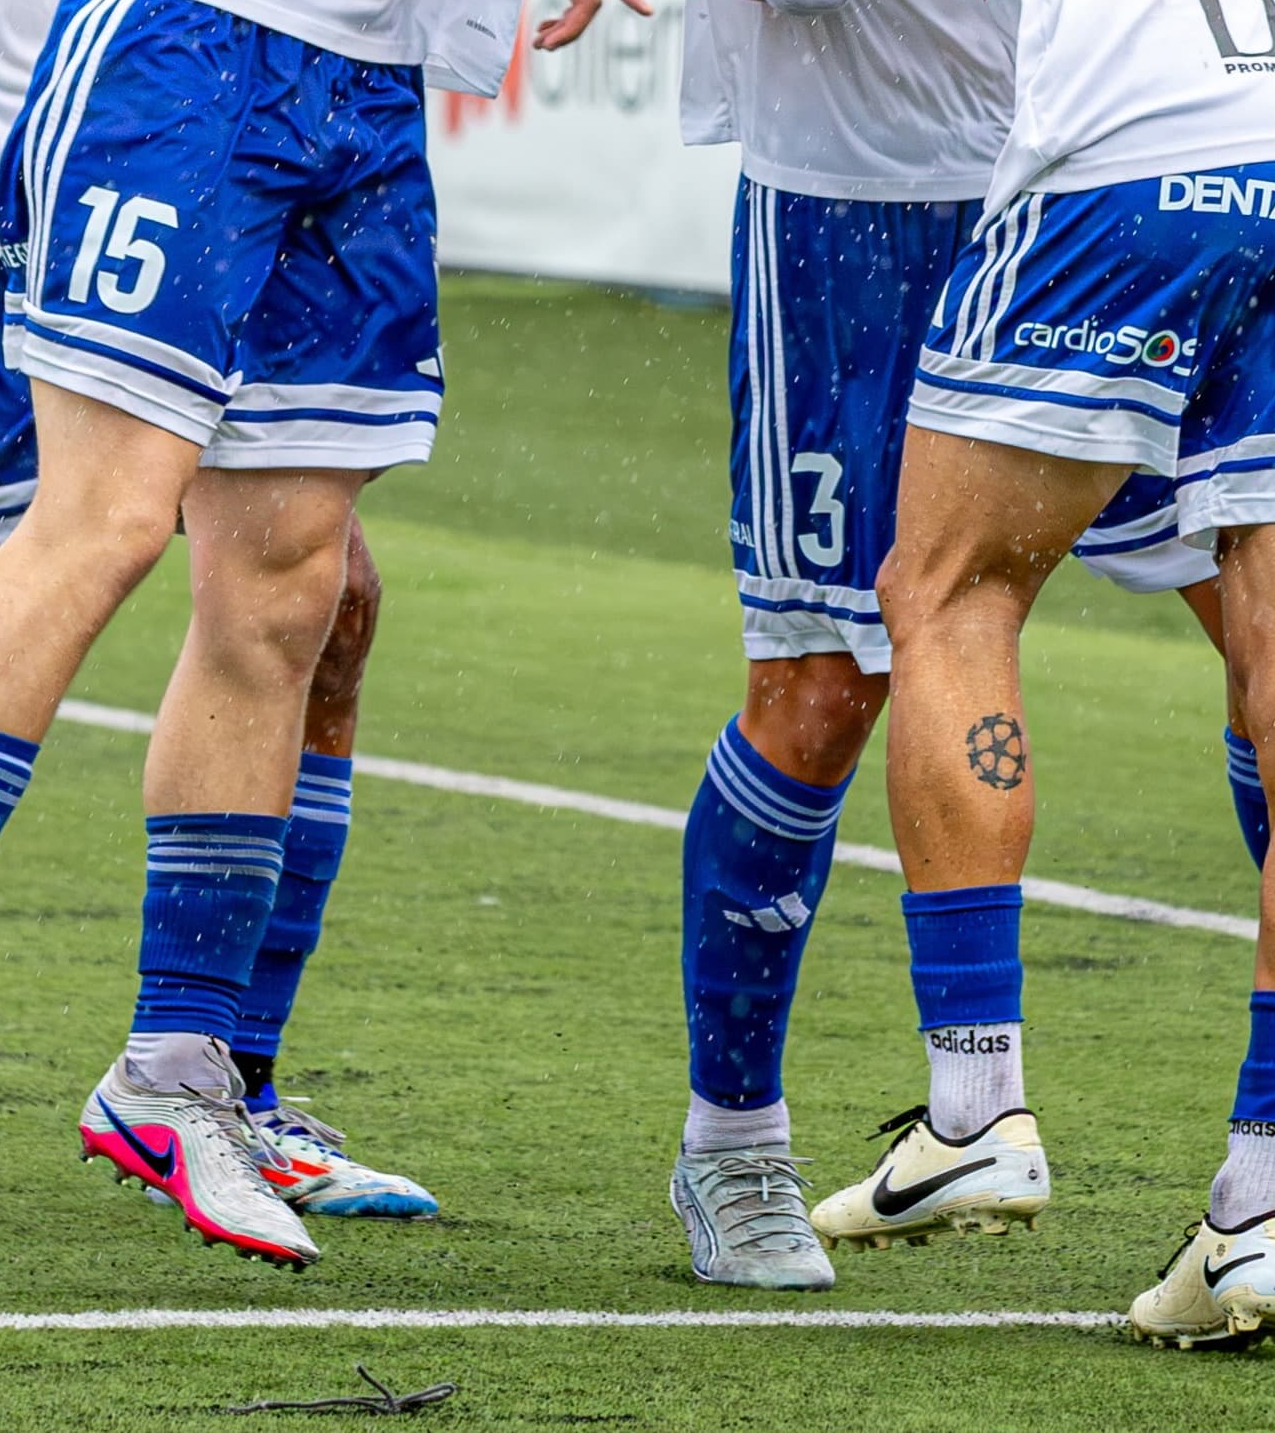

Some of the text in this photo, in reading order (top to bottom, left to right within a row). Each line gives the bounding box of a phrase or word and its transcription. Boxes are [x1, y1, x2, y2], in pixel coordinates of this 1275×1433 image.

[67, 185, 179, 315] 15
[790, 451, 846, 568] 3
[930, 1029, 1011, 1055] adidas
